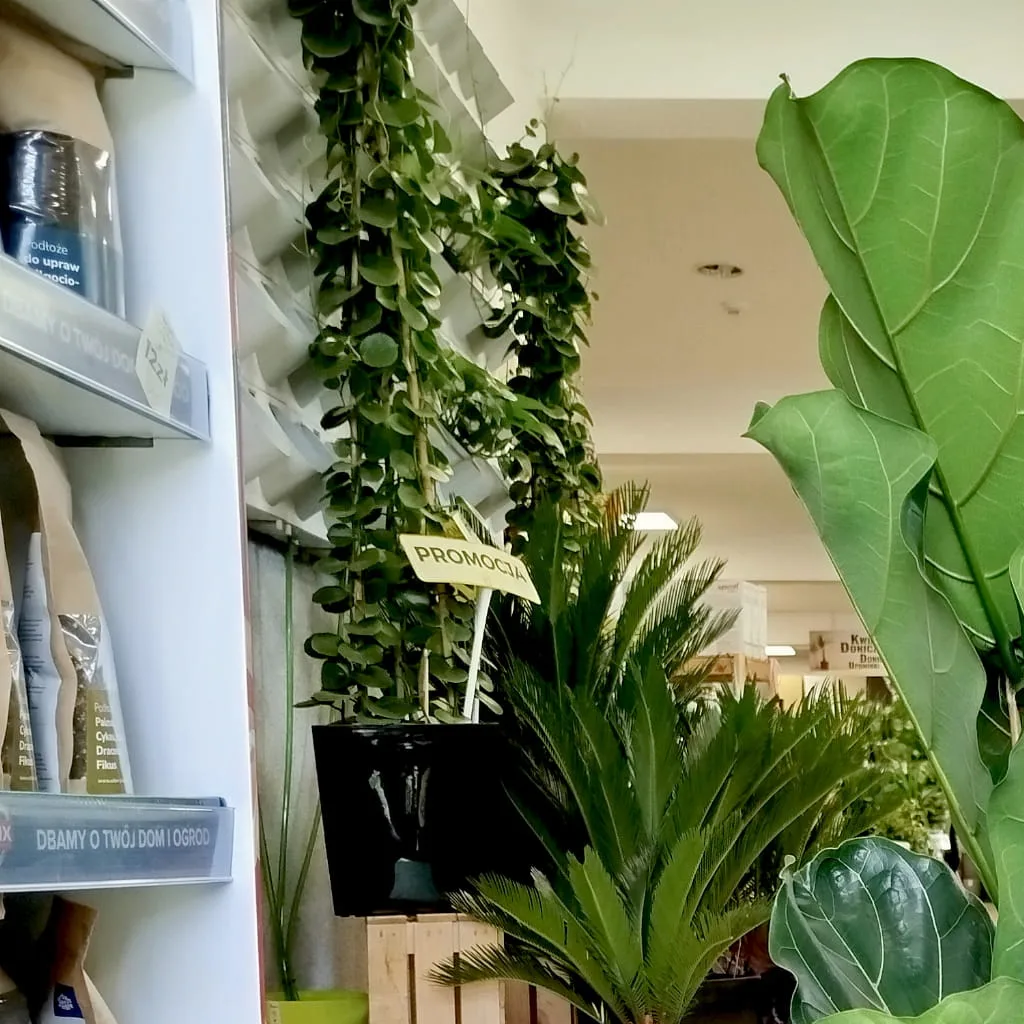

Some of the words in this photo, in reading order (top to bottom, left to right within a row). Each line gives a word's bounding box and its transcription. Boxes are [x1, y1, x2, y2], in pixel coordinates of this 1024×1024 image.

[31, 240, 69, 256] odłoże
[43, 258, 80, 272] upraw
[414, 546, 528, 583] PROMOCJA
[36, 828, 87, 850] DBAMY
[90, 829, 100, 849] O
[103, 824, 136, 849] TWÓJ
[138, 827, 165, 848] DOM
[167, 829, 171, 847] I
